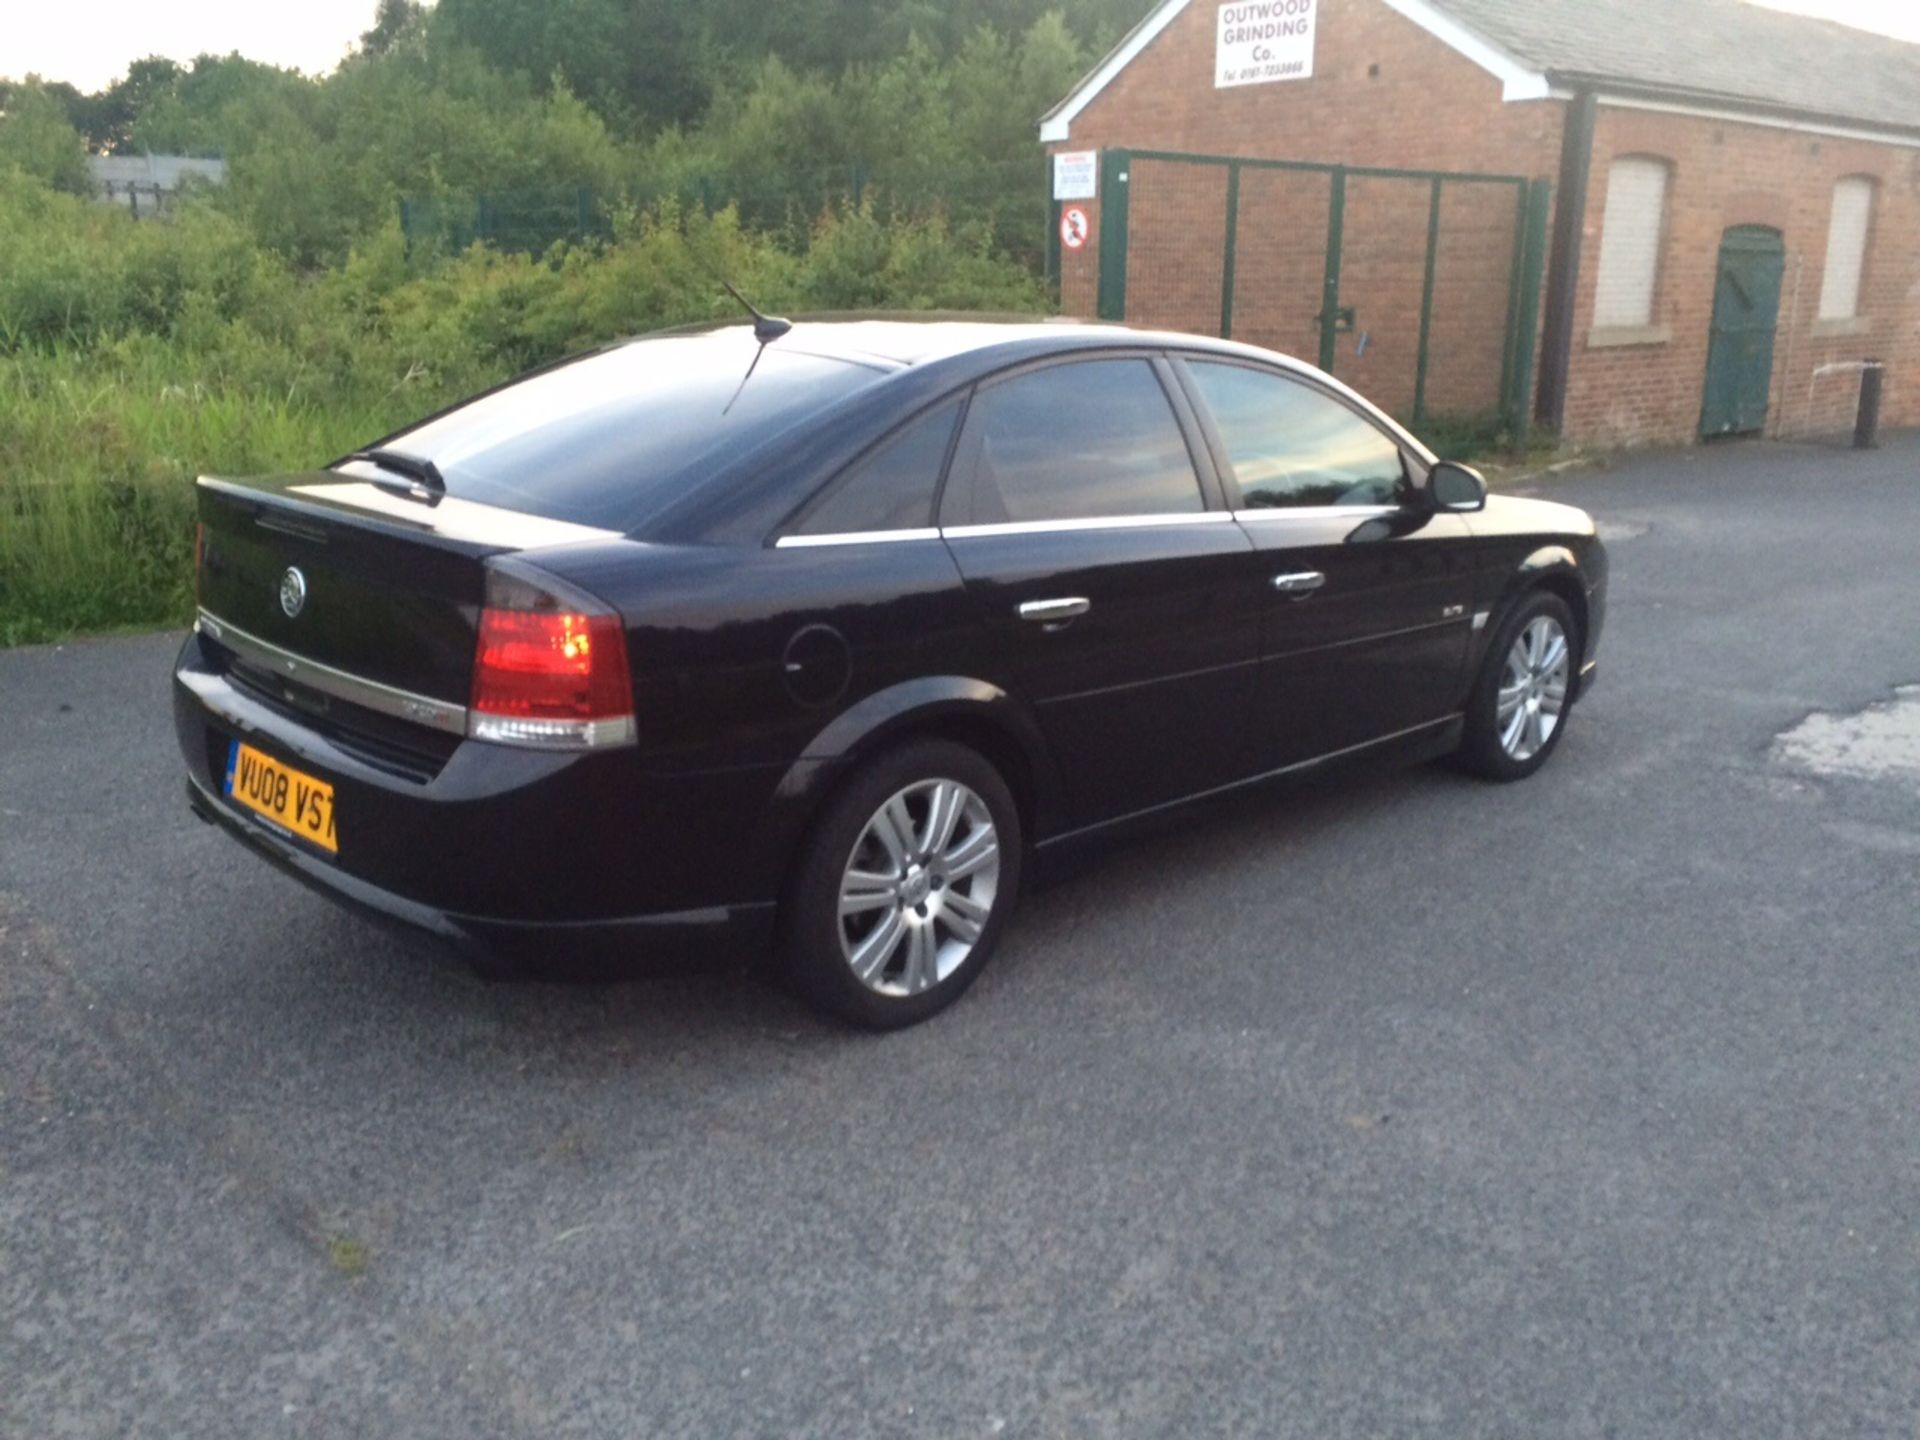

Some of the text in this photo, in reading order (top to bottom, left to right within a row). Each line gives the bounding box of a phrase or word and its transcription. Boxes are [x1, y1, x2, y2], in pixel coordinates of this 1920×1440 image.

[1223, 0, 1311, 24] OUTWOOD
[1223, 18, 1309, 45] GRINDING
[1252, 45, 1276, 62] Co.
[240, 752, 290, 814] VU08
